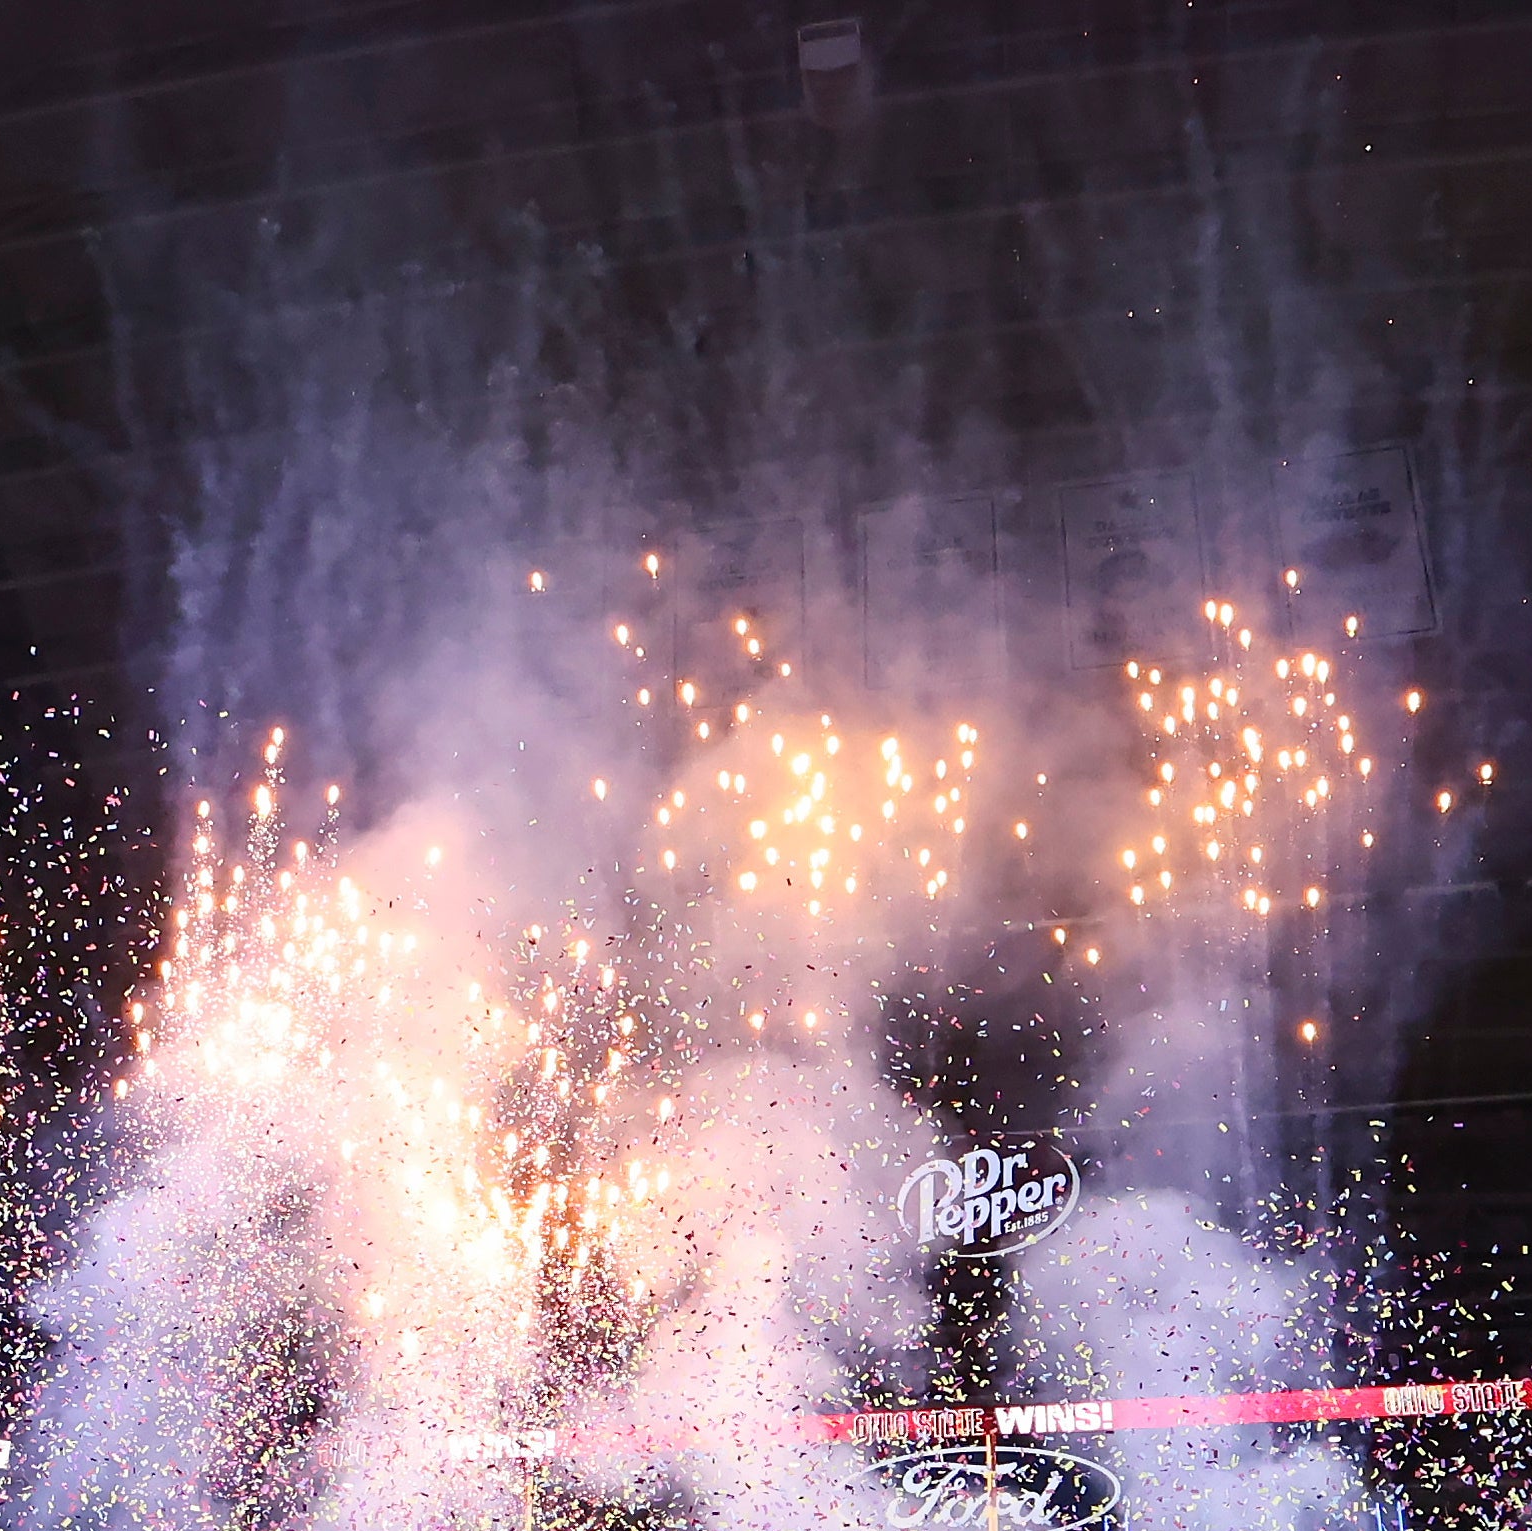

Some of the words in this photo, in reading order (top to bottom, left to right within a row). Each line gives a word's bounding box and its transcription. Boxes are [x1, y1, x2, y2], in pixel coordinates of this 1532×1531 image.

[915, 1157, 1067, 1246] Pepper
[965, 1148, 1029, 1198] Dr
[995, 1403, 1114, 1437] WINS!
[887, 1457, 1059, 1529] Ford
